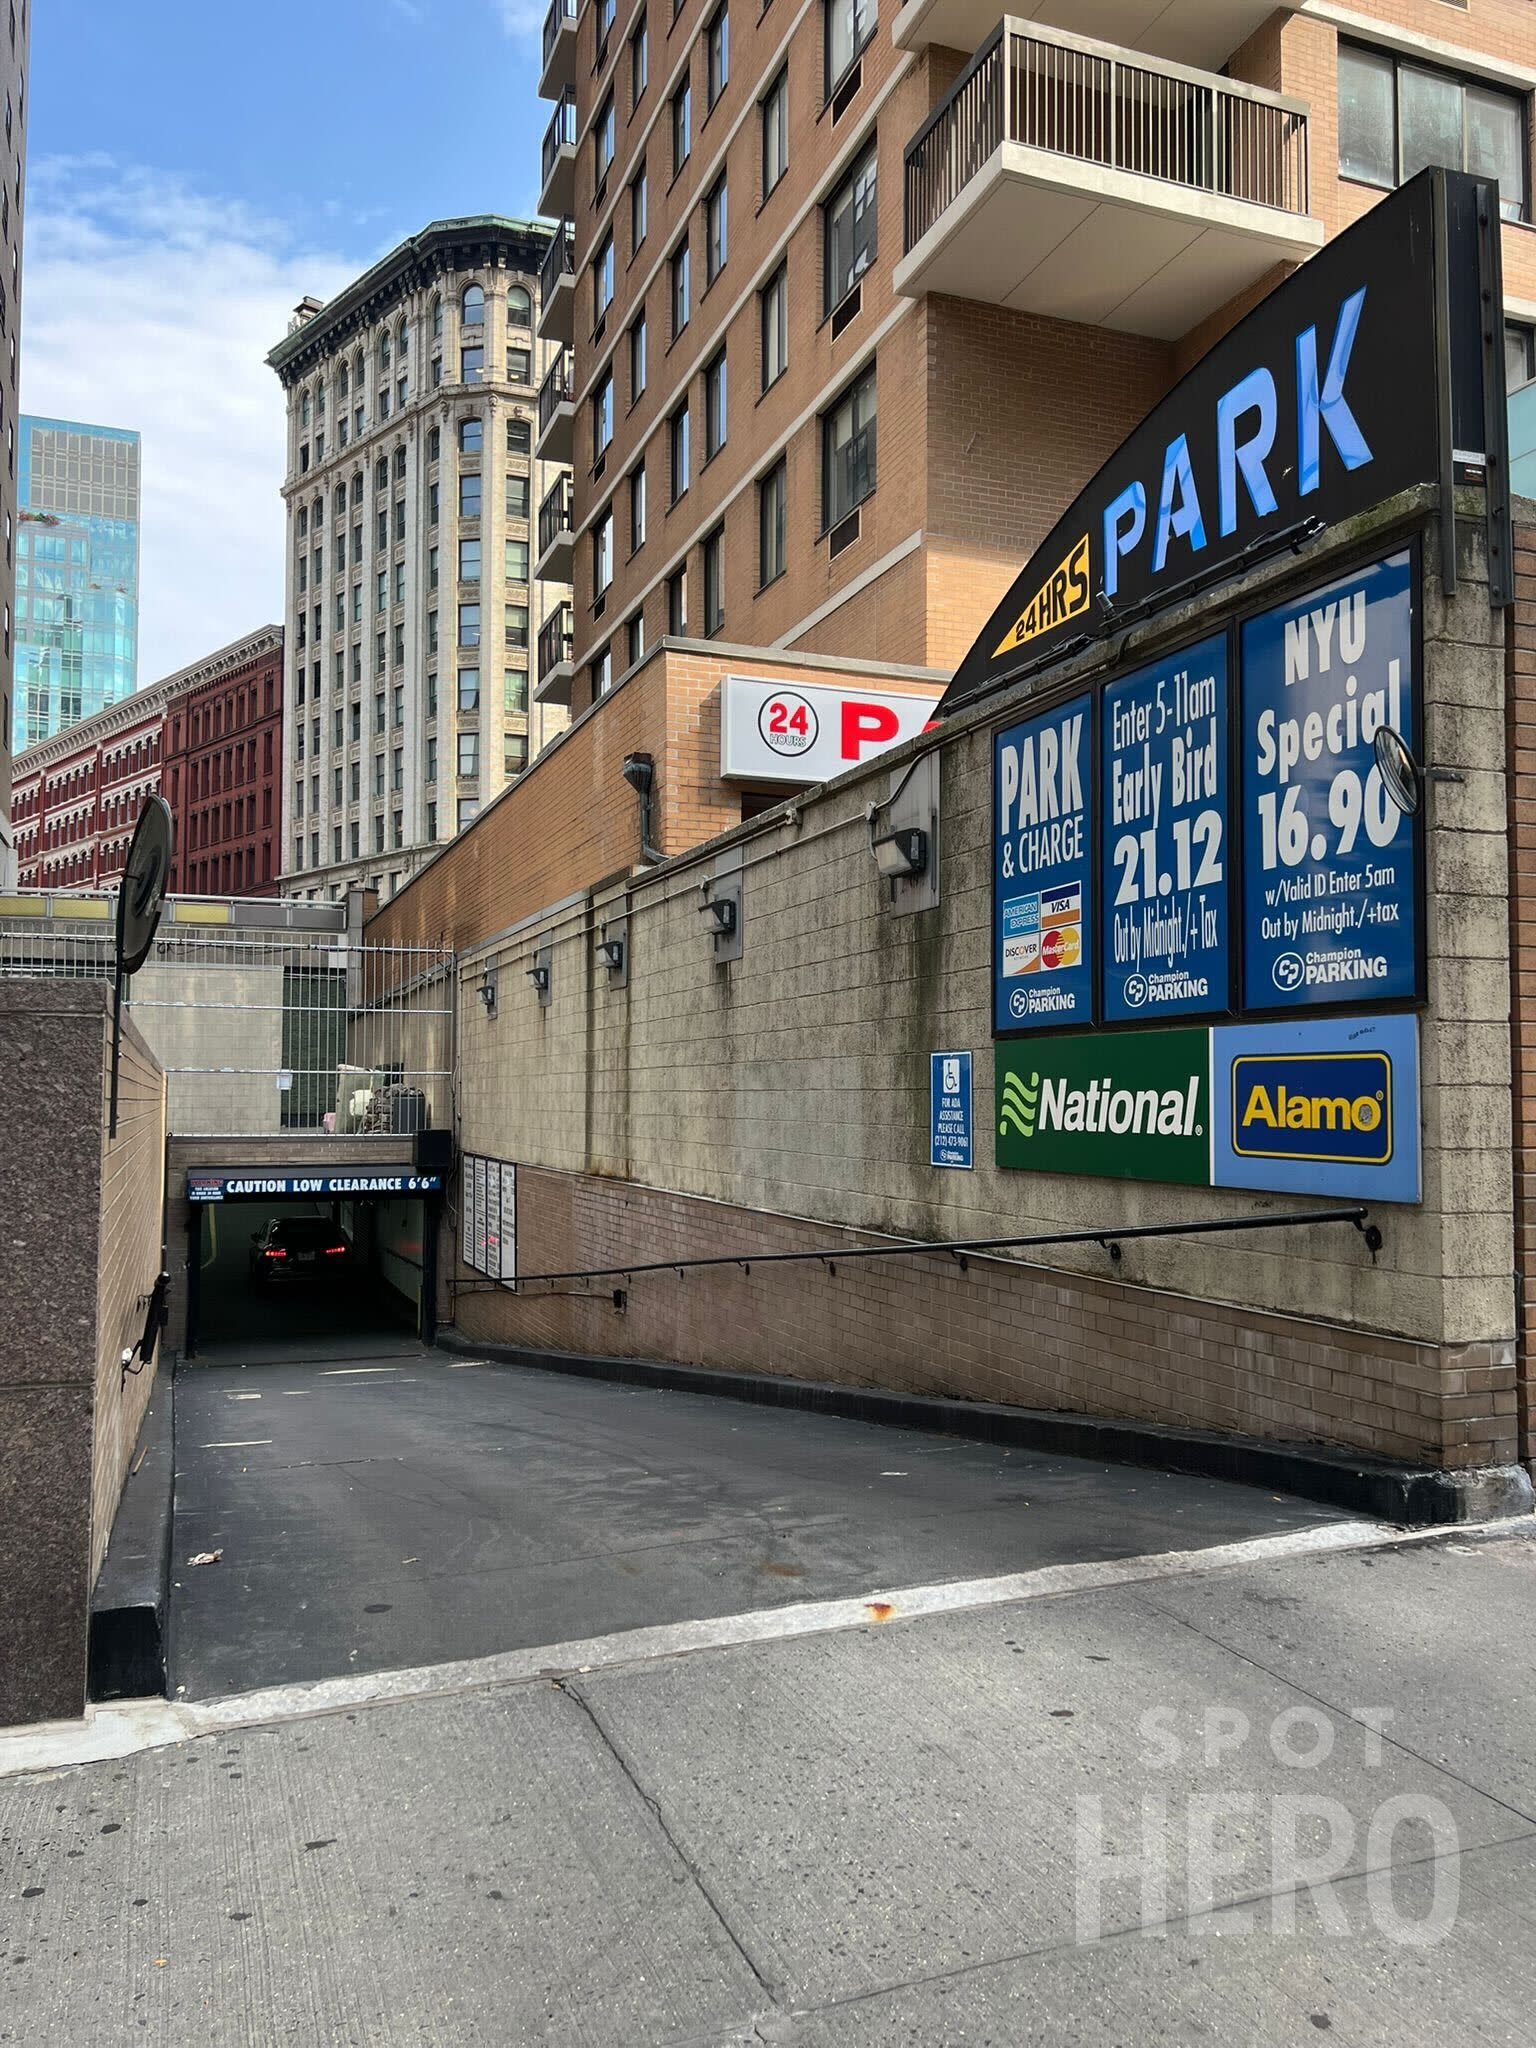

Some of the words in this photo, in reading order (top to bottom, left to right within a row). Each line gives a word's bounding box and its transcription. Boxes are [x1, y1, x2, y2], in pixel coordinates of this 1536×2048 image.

[1103, 285, 1374, 597] PARK
[1285, 590, 1366, 686] NYU
[769, 702, 809, 736] 24
[1113, 700, 1152, 751] Enter
[1155, 670, 1216, 735] 5-11am
[1257, 658, 1401, 784] Special
[769, 734, 807, 747] HOURS
[1001, 713, 1084, 836] PARK
[1113, 742, 1163, 829] Early
[1172, 716, 1217, 807] Bird
[1258, 763, 1401, 871] 16.90
[1002, 841, 1014, 879] &
[1018, 814, 1084, 874] CHARGE
[1113, 809, 1223, 906] 21.12
[1265, 874, 1311, 907] w/Valid
[1314, 873, 1326, 897] ID
[1329, 871, 1362, 895] Enter
[1365, 864, 1395, 888] 5am
[1003, 901, 1038, 919] AMERICAN
[1051, 899, 1070, 913] VISA
[1010, 913, 1039, 929] EXPRESS
[1262, 917, 1281, 939] Out
[1284, 912, 1298, 941] by
[1005, 943, 1037, 958] DISCOVER
[1042, 939, 1080, 956] MasterCard
[1114, 912, 1128, 963] Out
[1130, 905, 1141, 973] by
[1306, 947, 1362, 964] Champion
[1148, 970, 1190, 984] Champion
[1306, 956, 1387, 985] PARKING
[1028, 986, 1061, 998] Champion
[1028, 993, 1075, 1013] PARKING
[1148, 978, 1208, 1002] PARKING
[942, 1097, 951, 1108] FOR
[1038, 1076, 1199, 1136] National
[1241, 1085, 1382, 1132] Alamo
[937, 1123, 953, 1134] PLEASE
[226, 1180, 286, 1193] CAUTION
[292, 1179, 323, 1192] LOW
[329, 1178, 402, 1191] CLEARANCE
